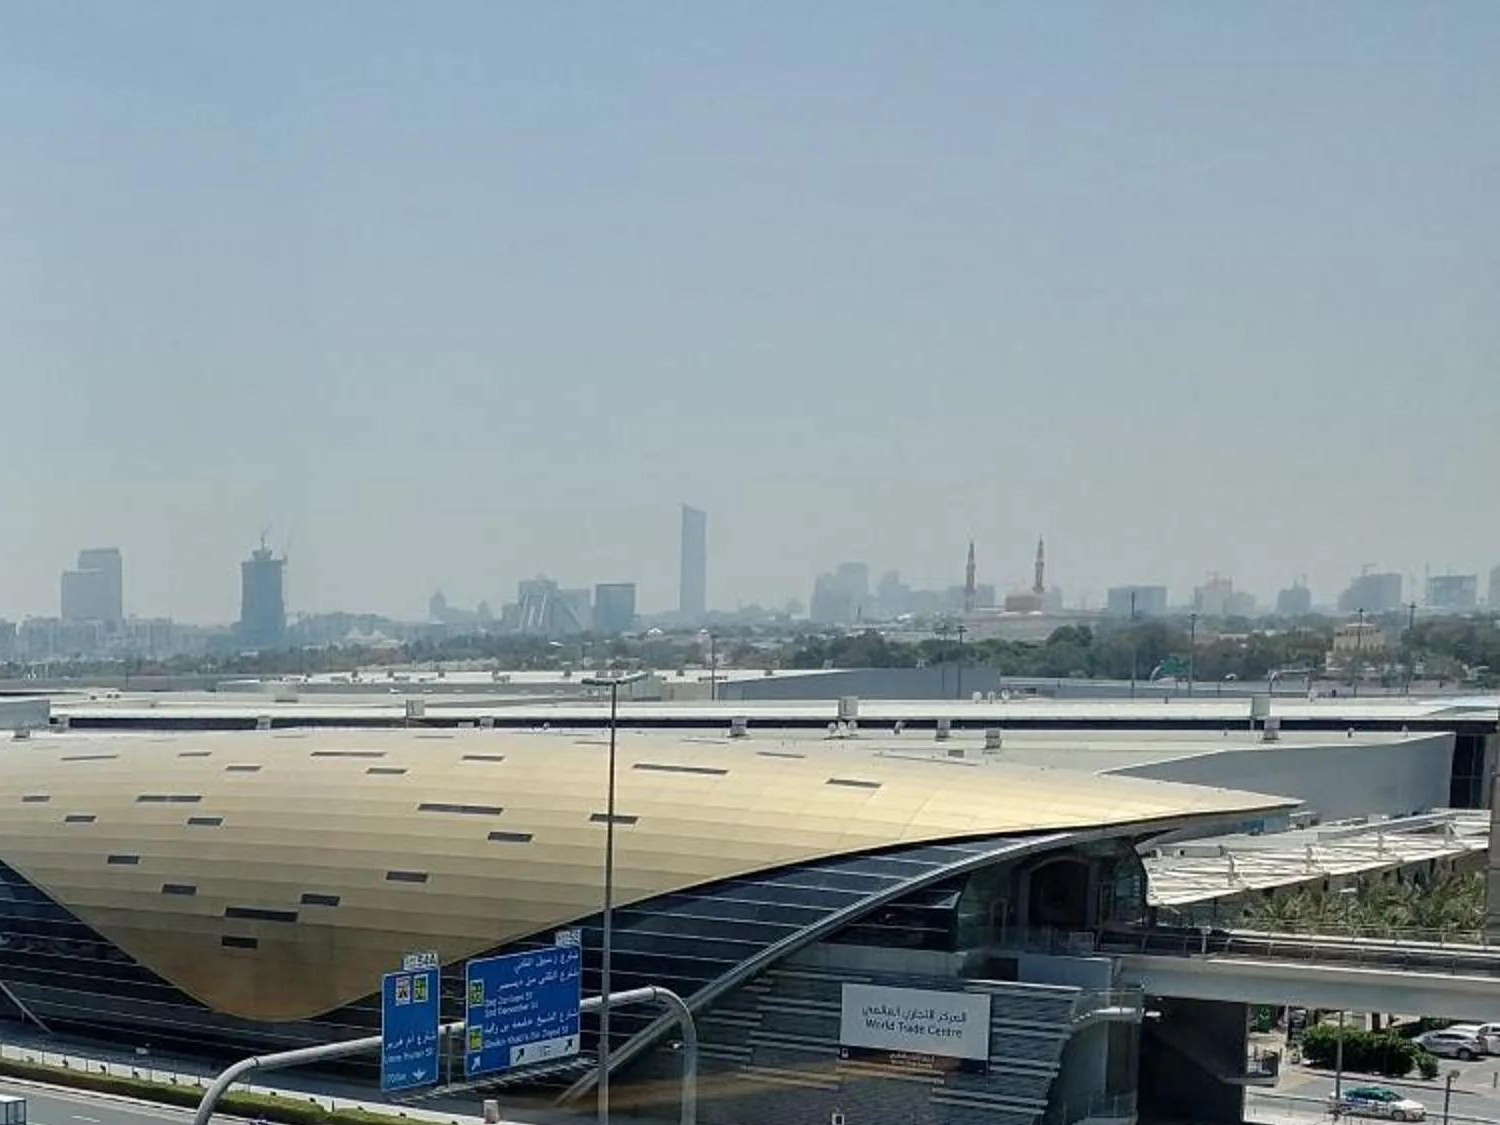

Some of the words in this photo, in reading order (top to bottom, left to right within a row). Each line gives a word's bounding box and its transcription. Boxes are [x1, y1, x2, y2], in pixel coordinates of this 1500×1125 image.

[865, 1018, 895, 1031] World
[898, 1021, 925, 1035] Trade
[928, 1026, 963, 1039] Centre
